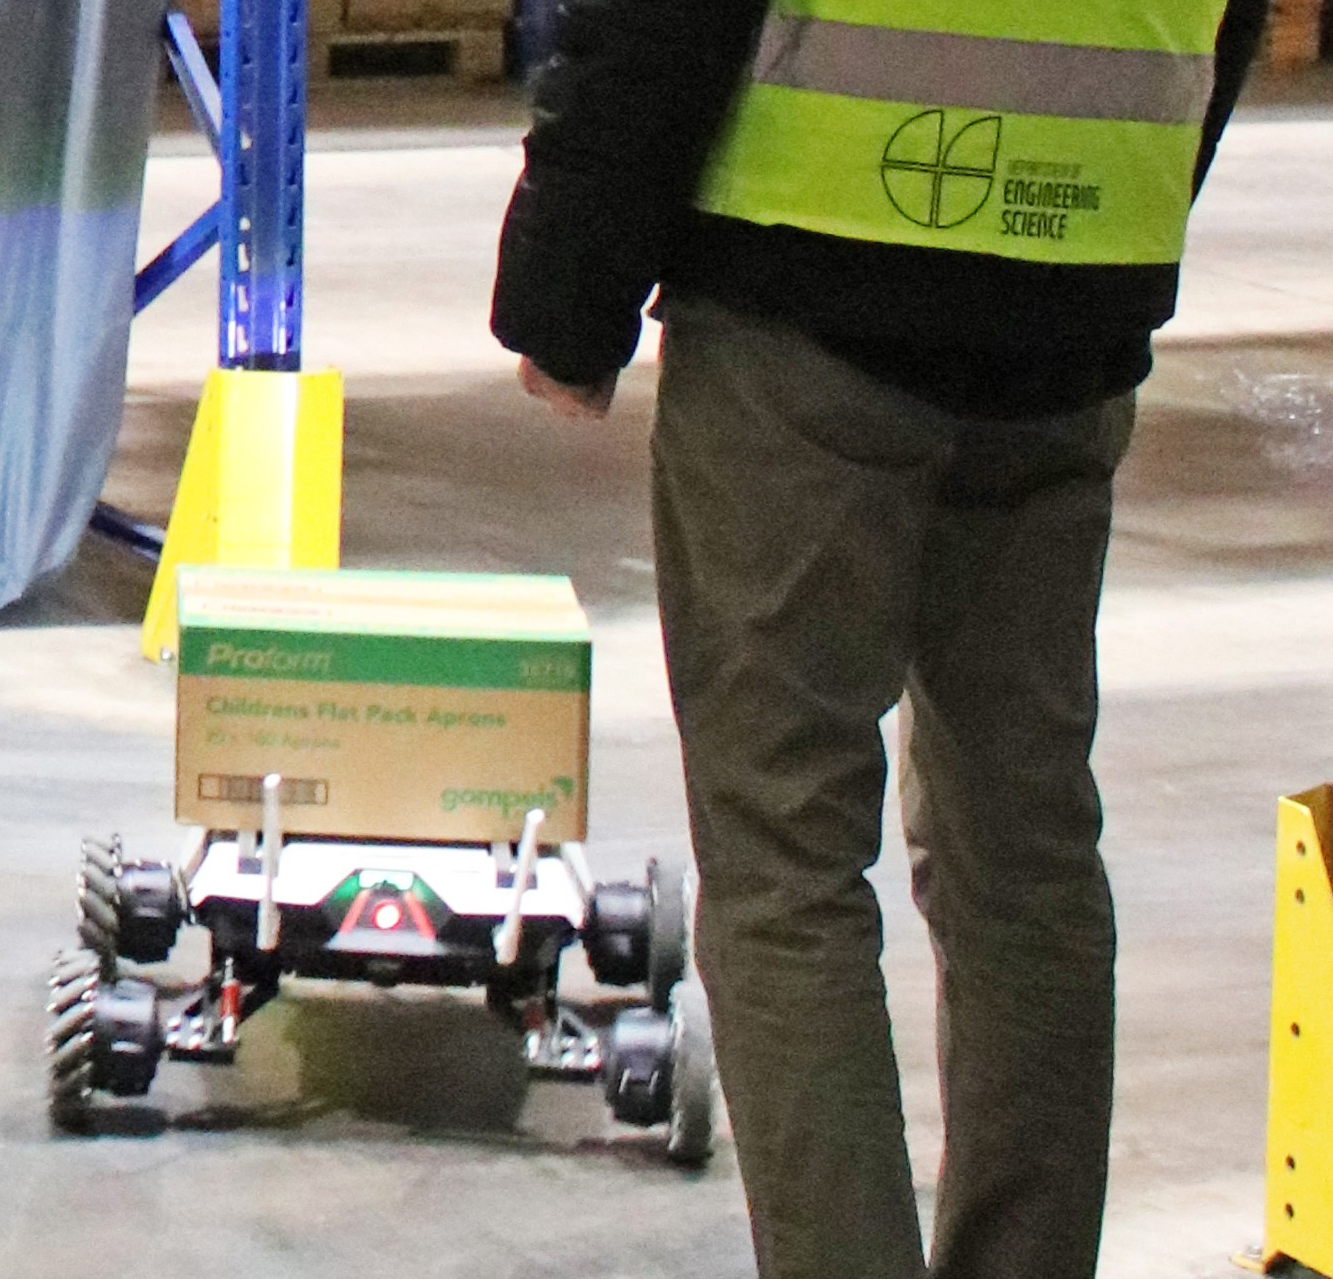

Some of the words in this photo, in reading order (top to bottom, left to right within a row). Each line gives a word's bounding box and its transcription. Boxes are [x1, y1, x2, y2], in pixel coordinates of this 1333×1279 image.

[1004, 180, 1099, 209] ENGINEERING
[1002, 210, 1067, 238] SCIENCE
[206, 642, 332, 674] Proform
[205, 695, 309, 721] Childrens
[317, 702, 358, 722] Flat
[366, 703, 418, 724] Pack
[427, 705, 508, 731] Aprons
